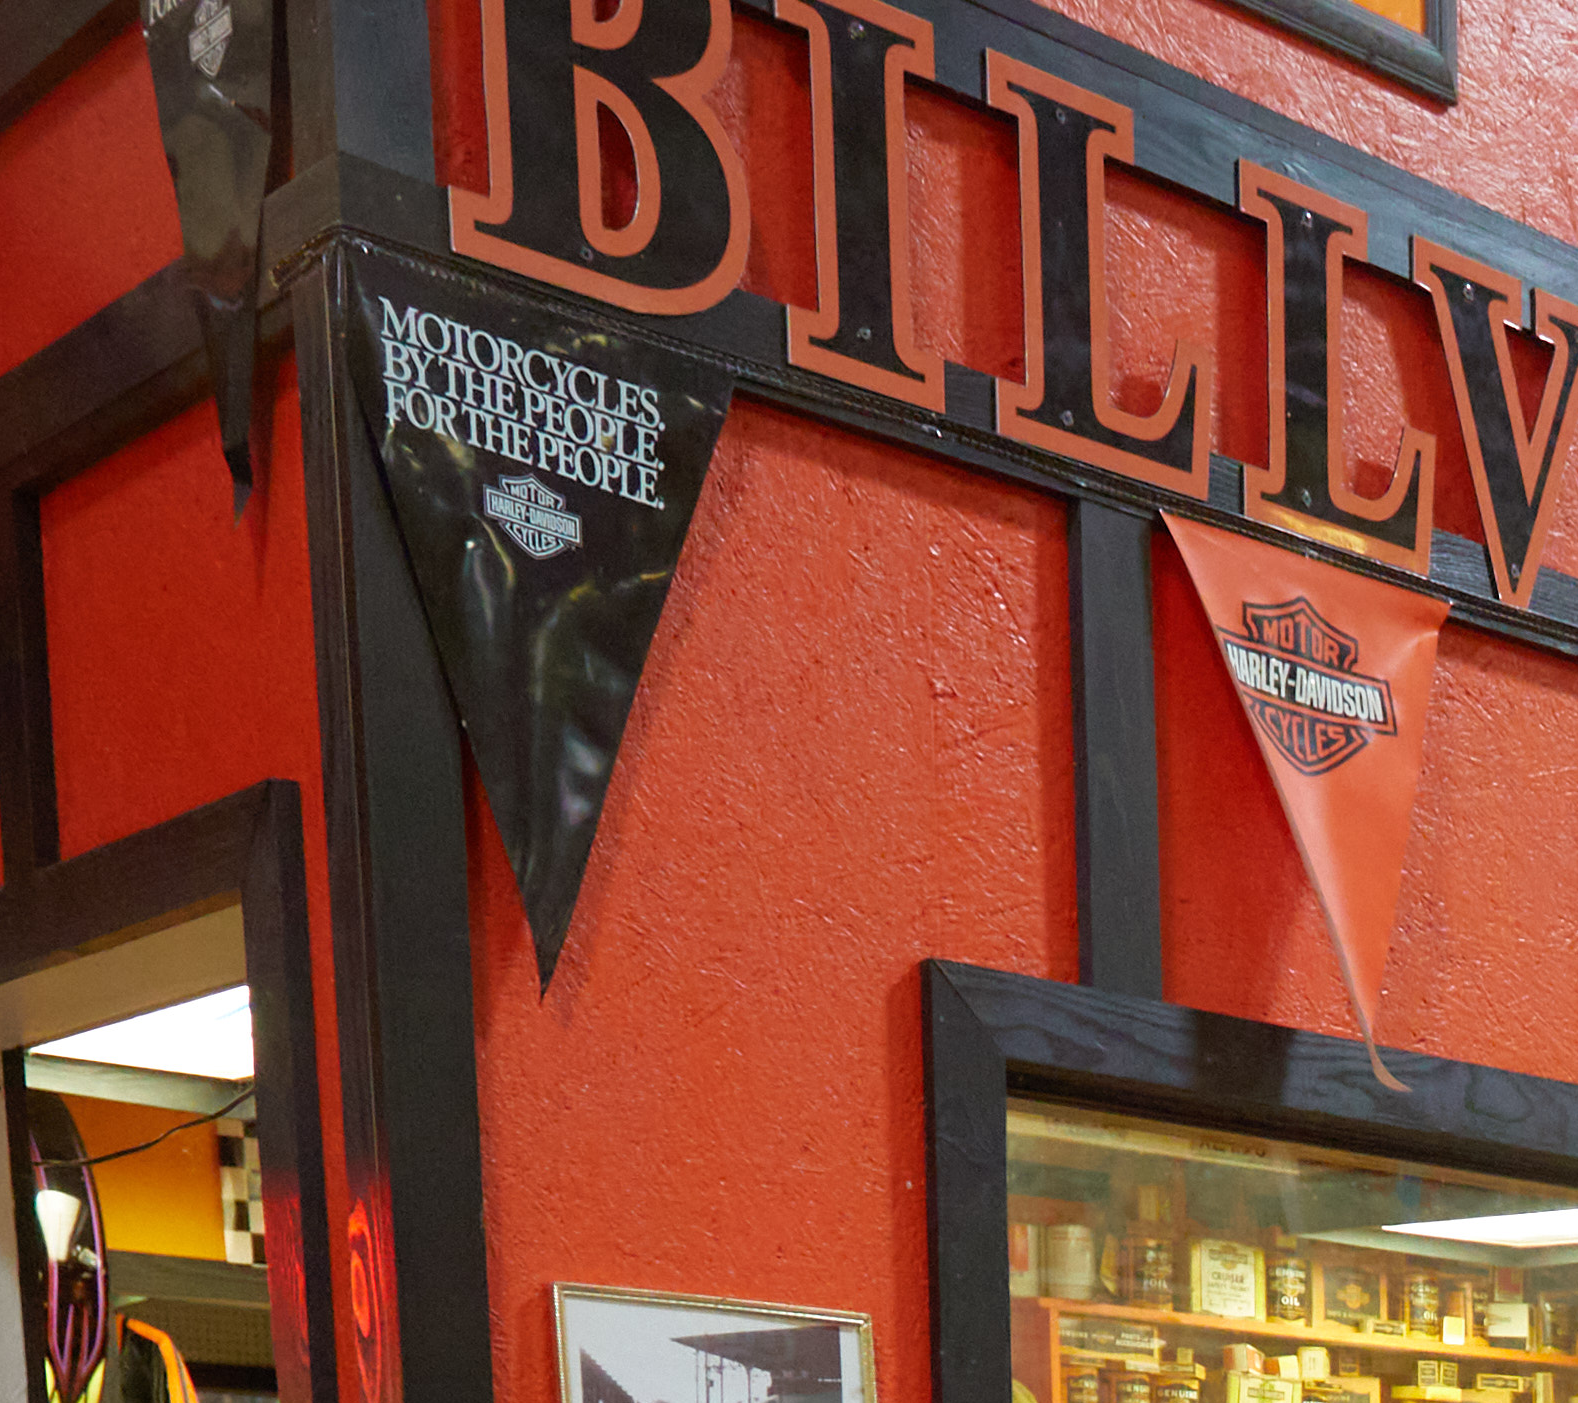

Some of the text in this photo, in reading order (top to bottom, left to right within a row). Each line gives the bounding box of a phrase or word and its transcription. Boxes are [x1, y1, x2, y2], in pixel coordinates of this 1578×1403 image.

[378, 295, 666, 432] MOTORCYCLES.
[380, 337, 665, 472] BY THE PEOPLE.
[382, 377, 666, 512] FOR THE PEOPLE.
[490, 494, 577, 539] HARLEY-DAVIDSON
[509, 482, 556, 509] MOTOR
[511, 522, 558, 551] CYCLES
[1262, 610, 1342, 666] MOTOR
[1225, 642, 1384, 722] HARLEY-DAVIDSON
[1263, 704, 1348, 763] CYCLES
[1280, 1295, 1301, 1307] OIL
